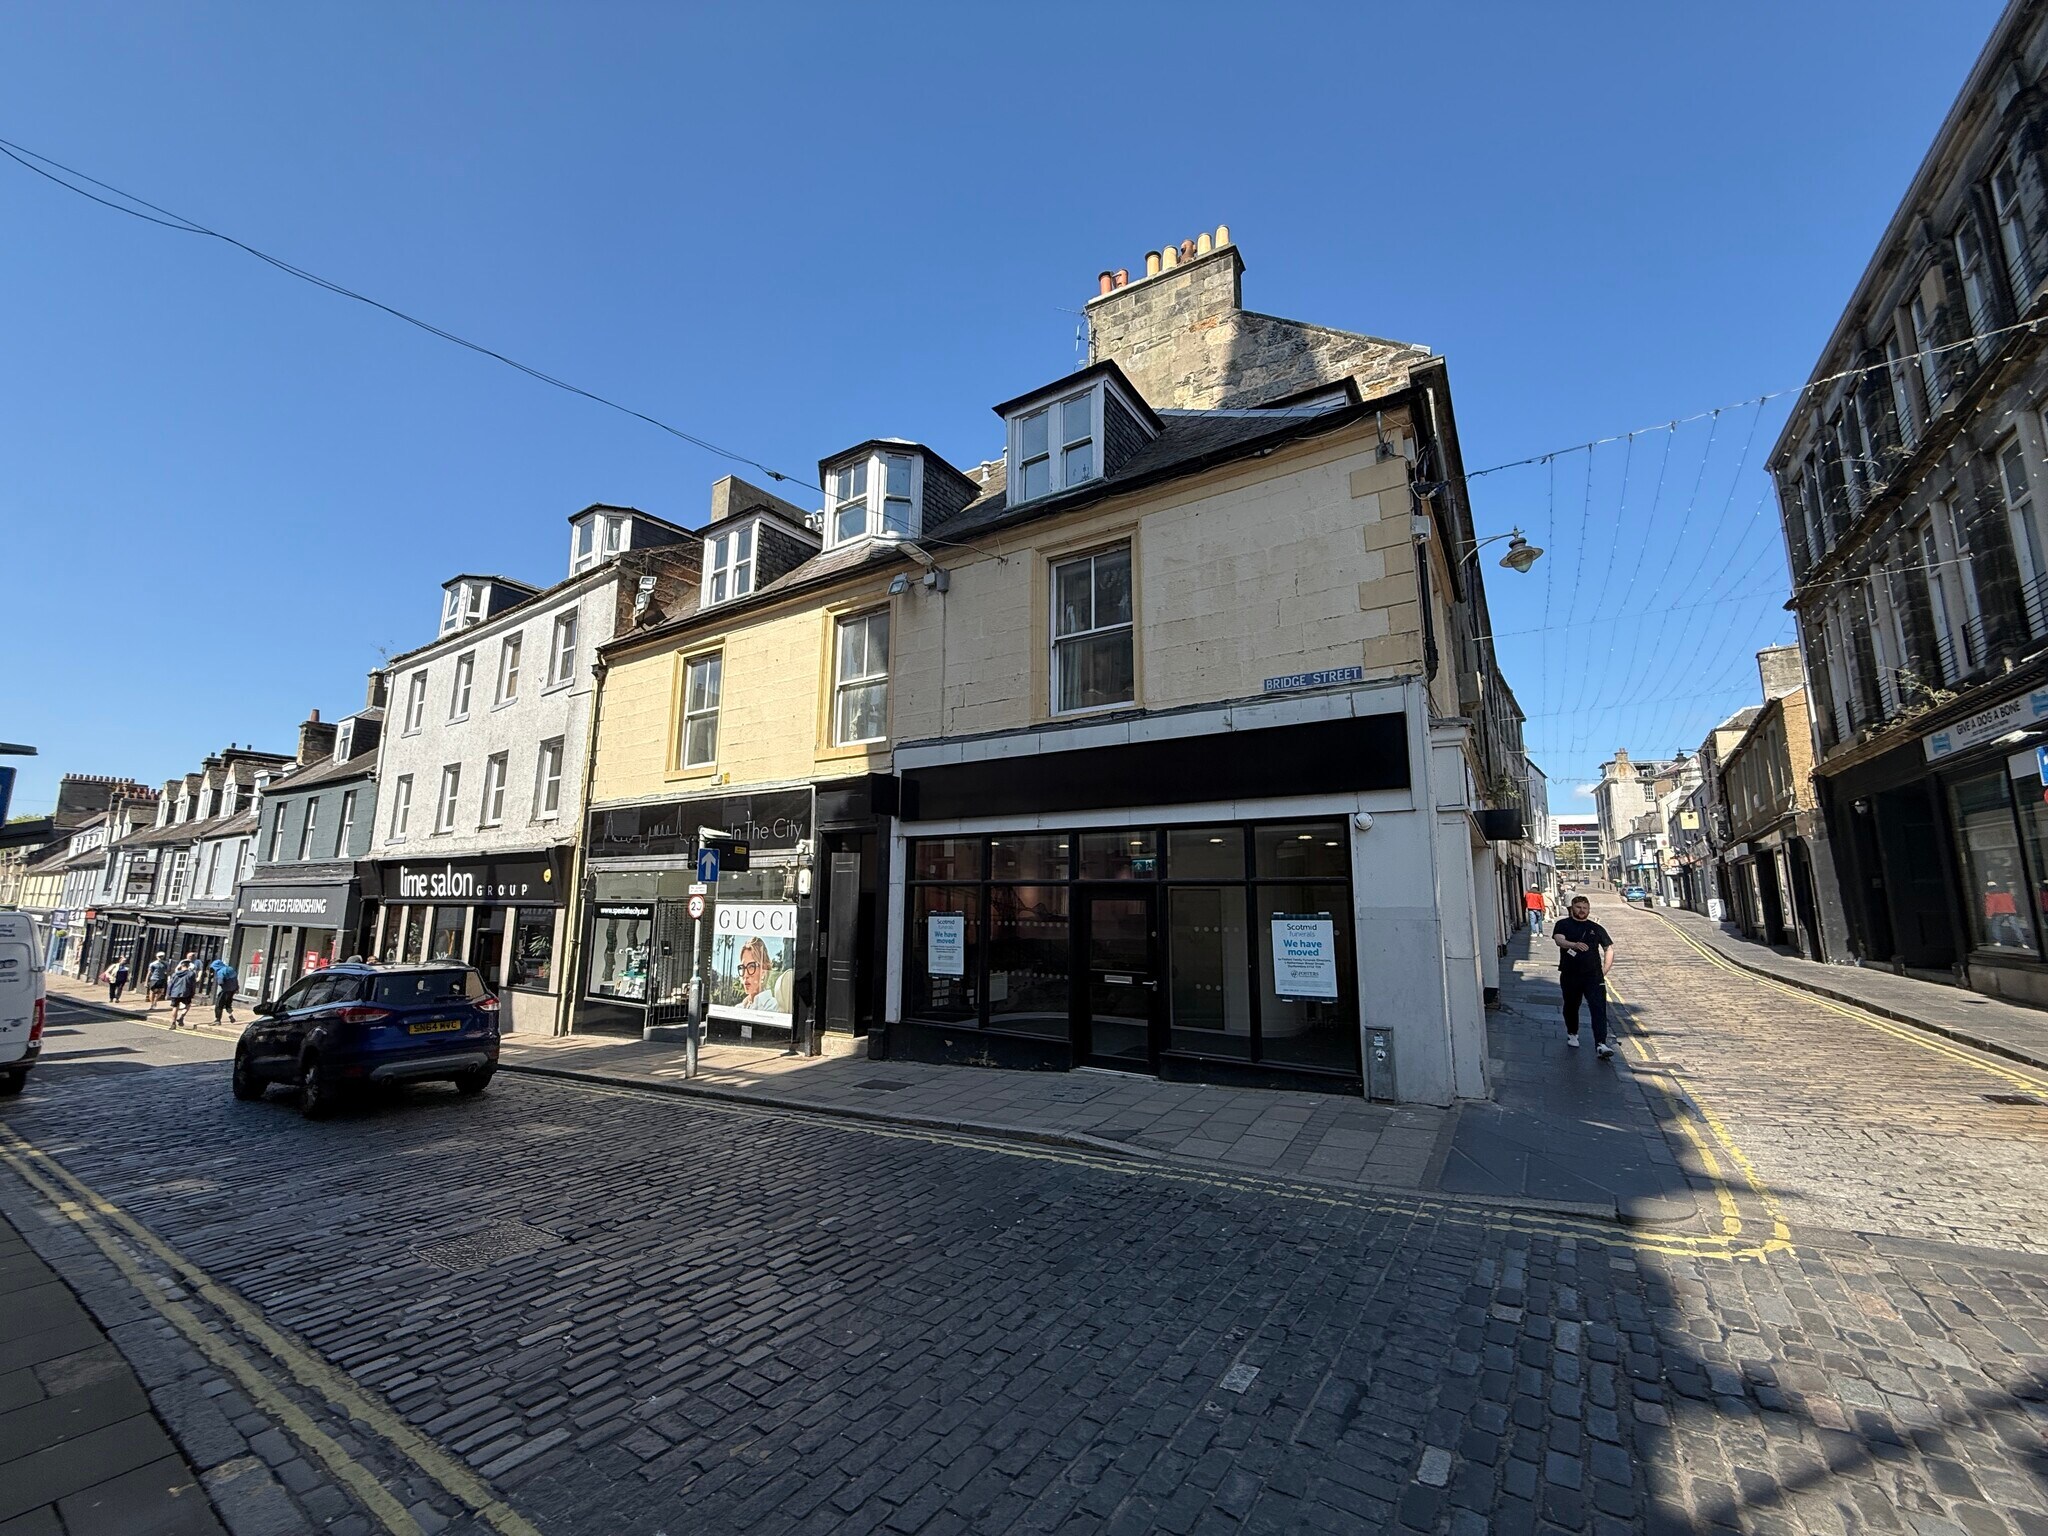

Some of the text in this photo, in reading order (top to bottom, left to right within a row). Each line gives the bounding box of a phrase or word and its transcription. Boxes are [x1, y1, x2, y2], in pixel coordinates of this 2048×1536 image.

[1266, 667, 1360, 690] BRIDGE STREET
[1956, 720, 1971, 735] GIVE
[1977, 712, 1993, 727] DOG
[1994, 711, 1999, 719] A
[2000, 701, 2021, 718] BONE
[731, 817, 804, 842] In The City
[400, 862, 529, 897] lime salon GROUP
[251, 899, 268, 912] HOME
[287, 898, 327, 914] FURNISHING
[719, 909, 793, 931] GUCCI
[1283, 939, 1323, 948] We have
[1287, 948, 1320, 956] moved
